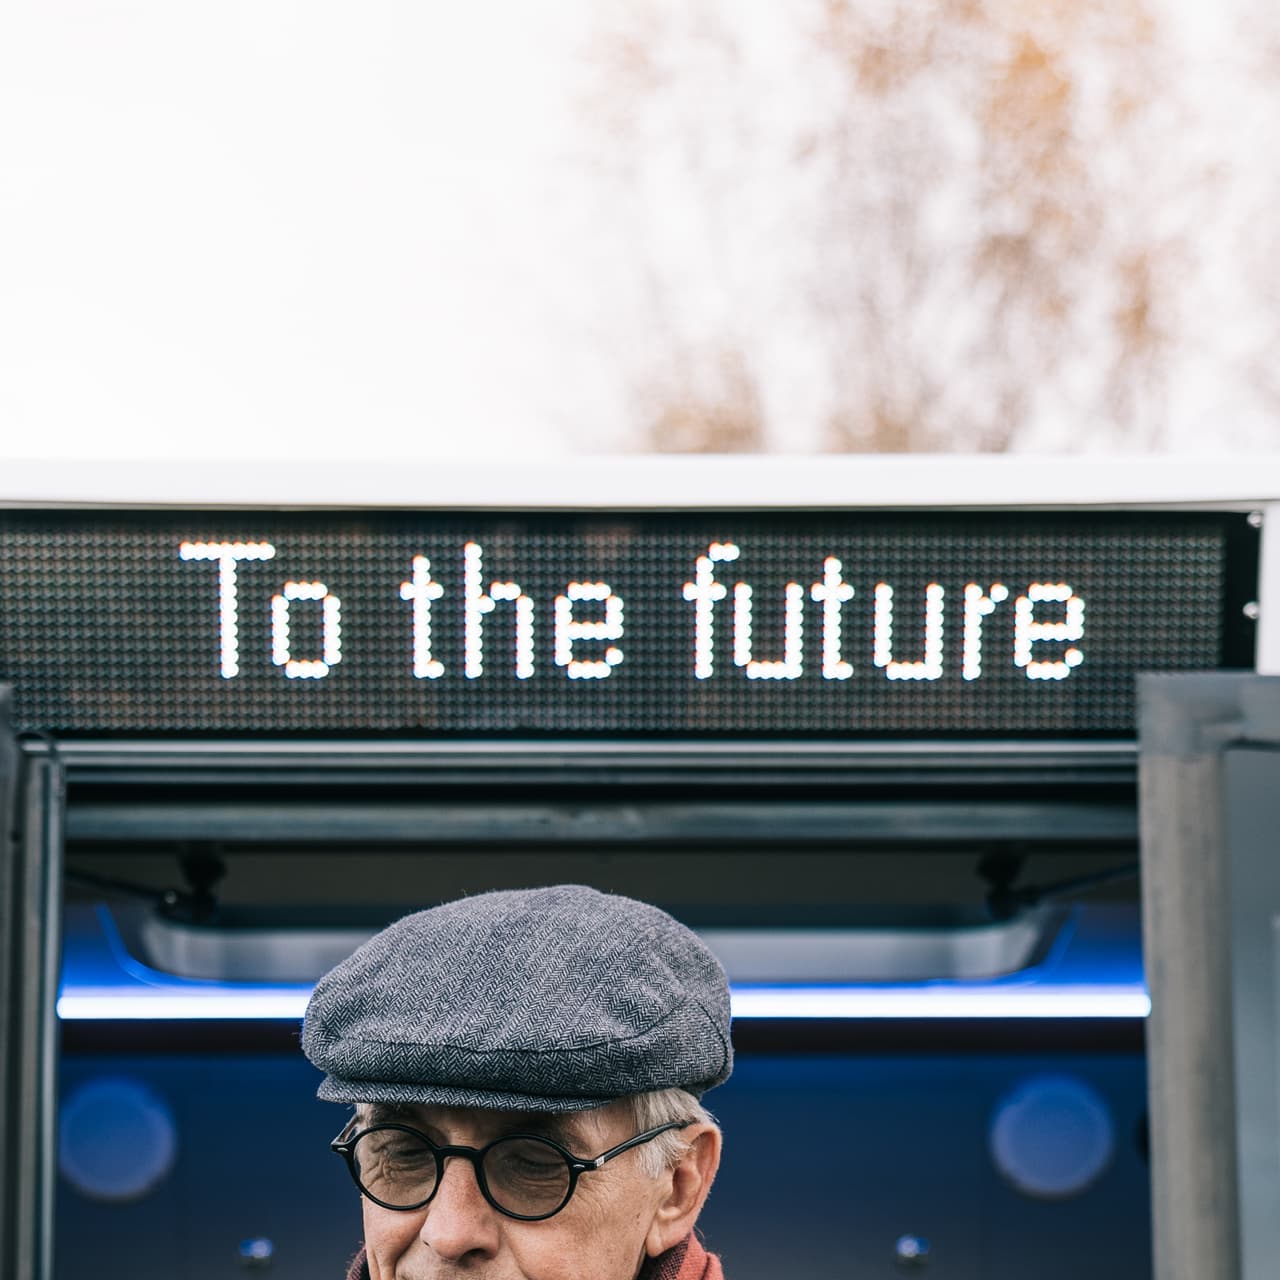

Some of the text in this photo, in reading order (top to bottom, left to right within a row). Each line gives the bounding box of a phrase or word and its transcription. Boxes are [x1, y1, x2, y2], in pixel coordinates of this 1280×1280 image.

[179, 541, 1086, 680] To the future
